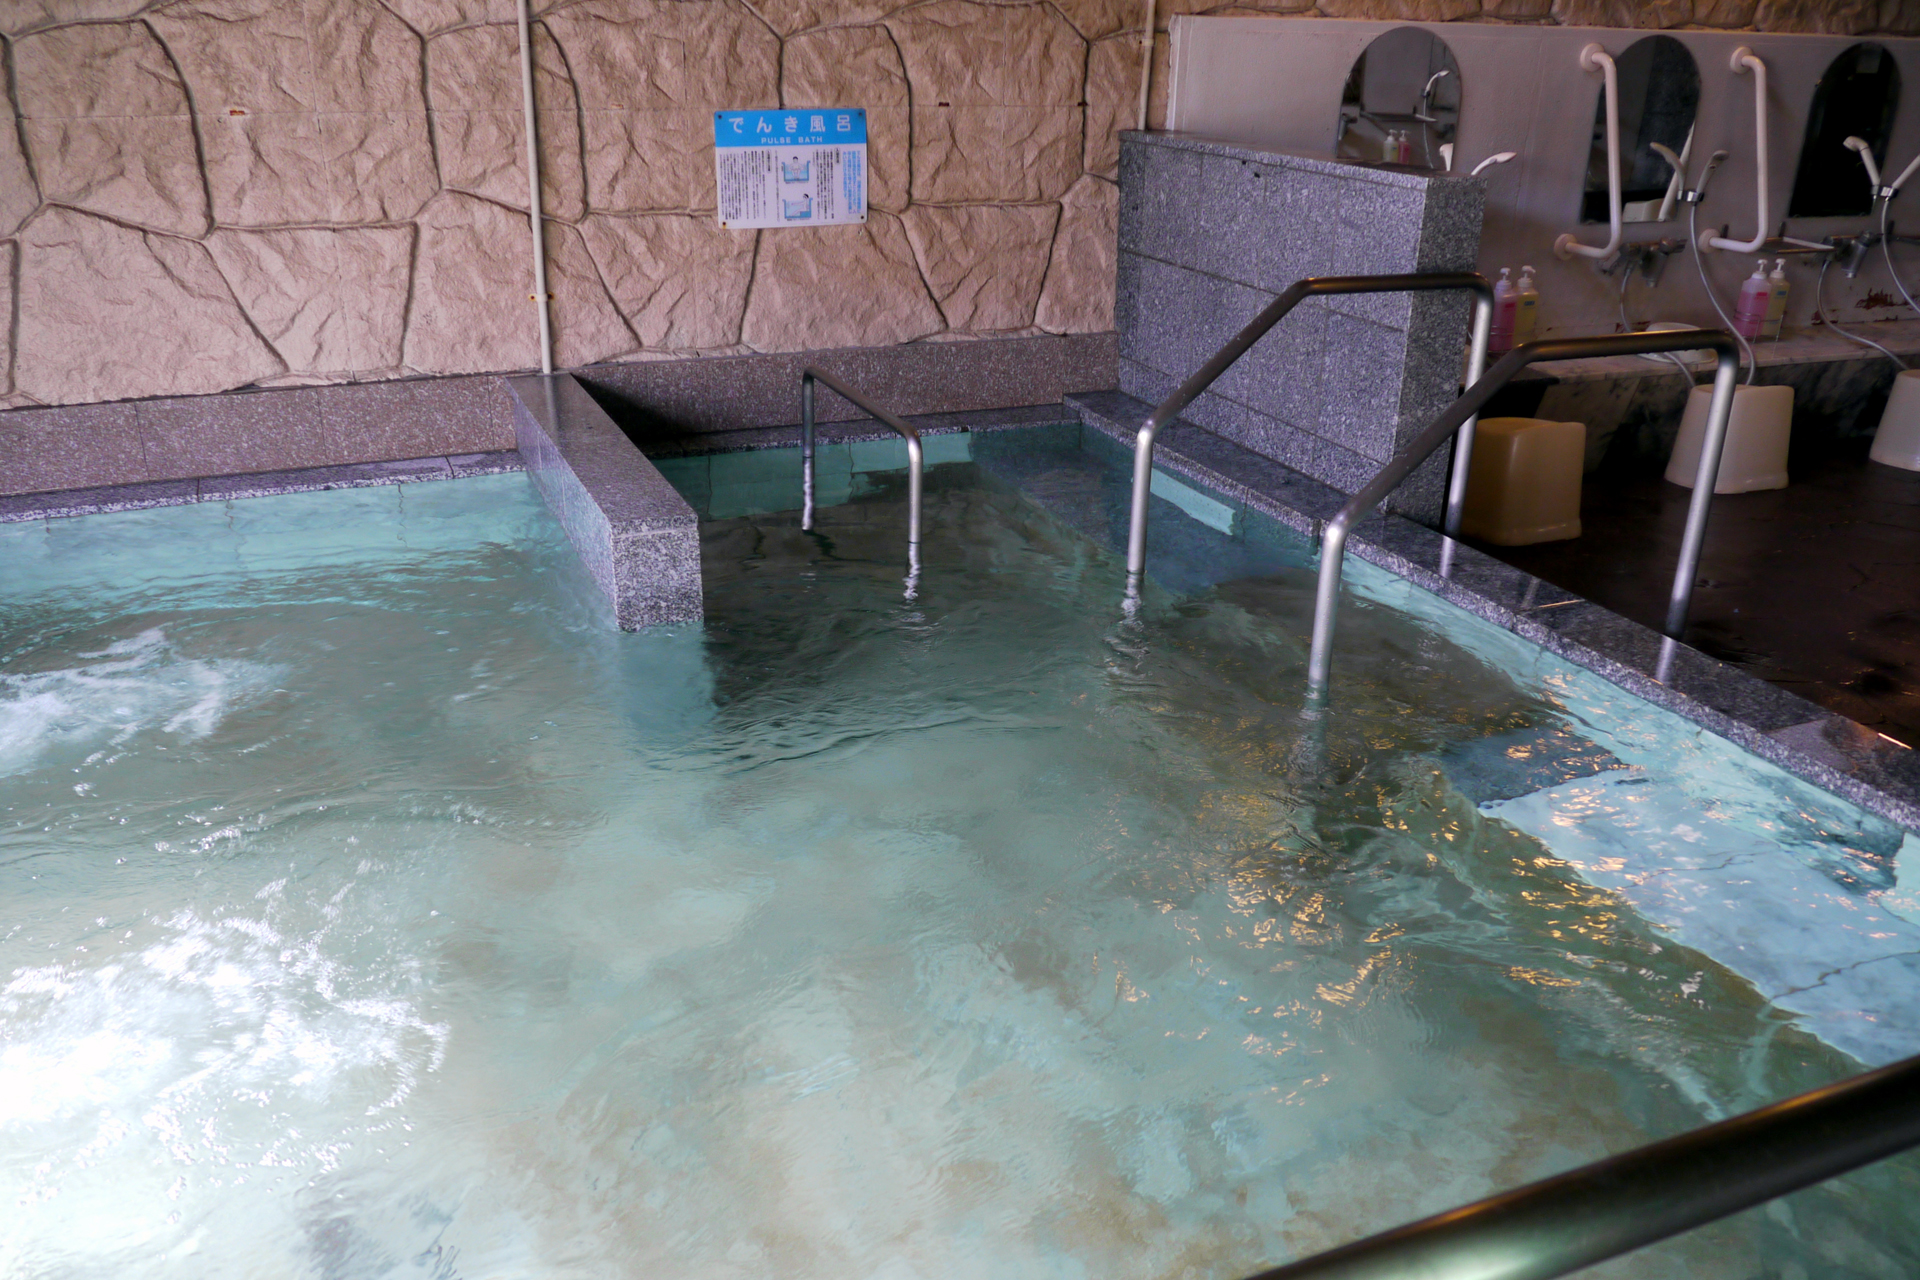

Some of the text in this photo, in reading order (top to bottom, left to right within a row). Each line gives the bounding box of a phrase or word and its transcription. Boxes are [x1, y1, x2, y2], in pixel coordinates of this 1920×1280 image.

[729, 115, 851, 133] でんき風呂
[761, 136, 791, 144] PULSE
